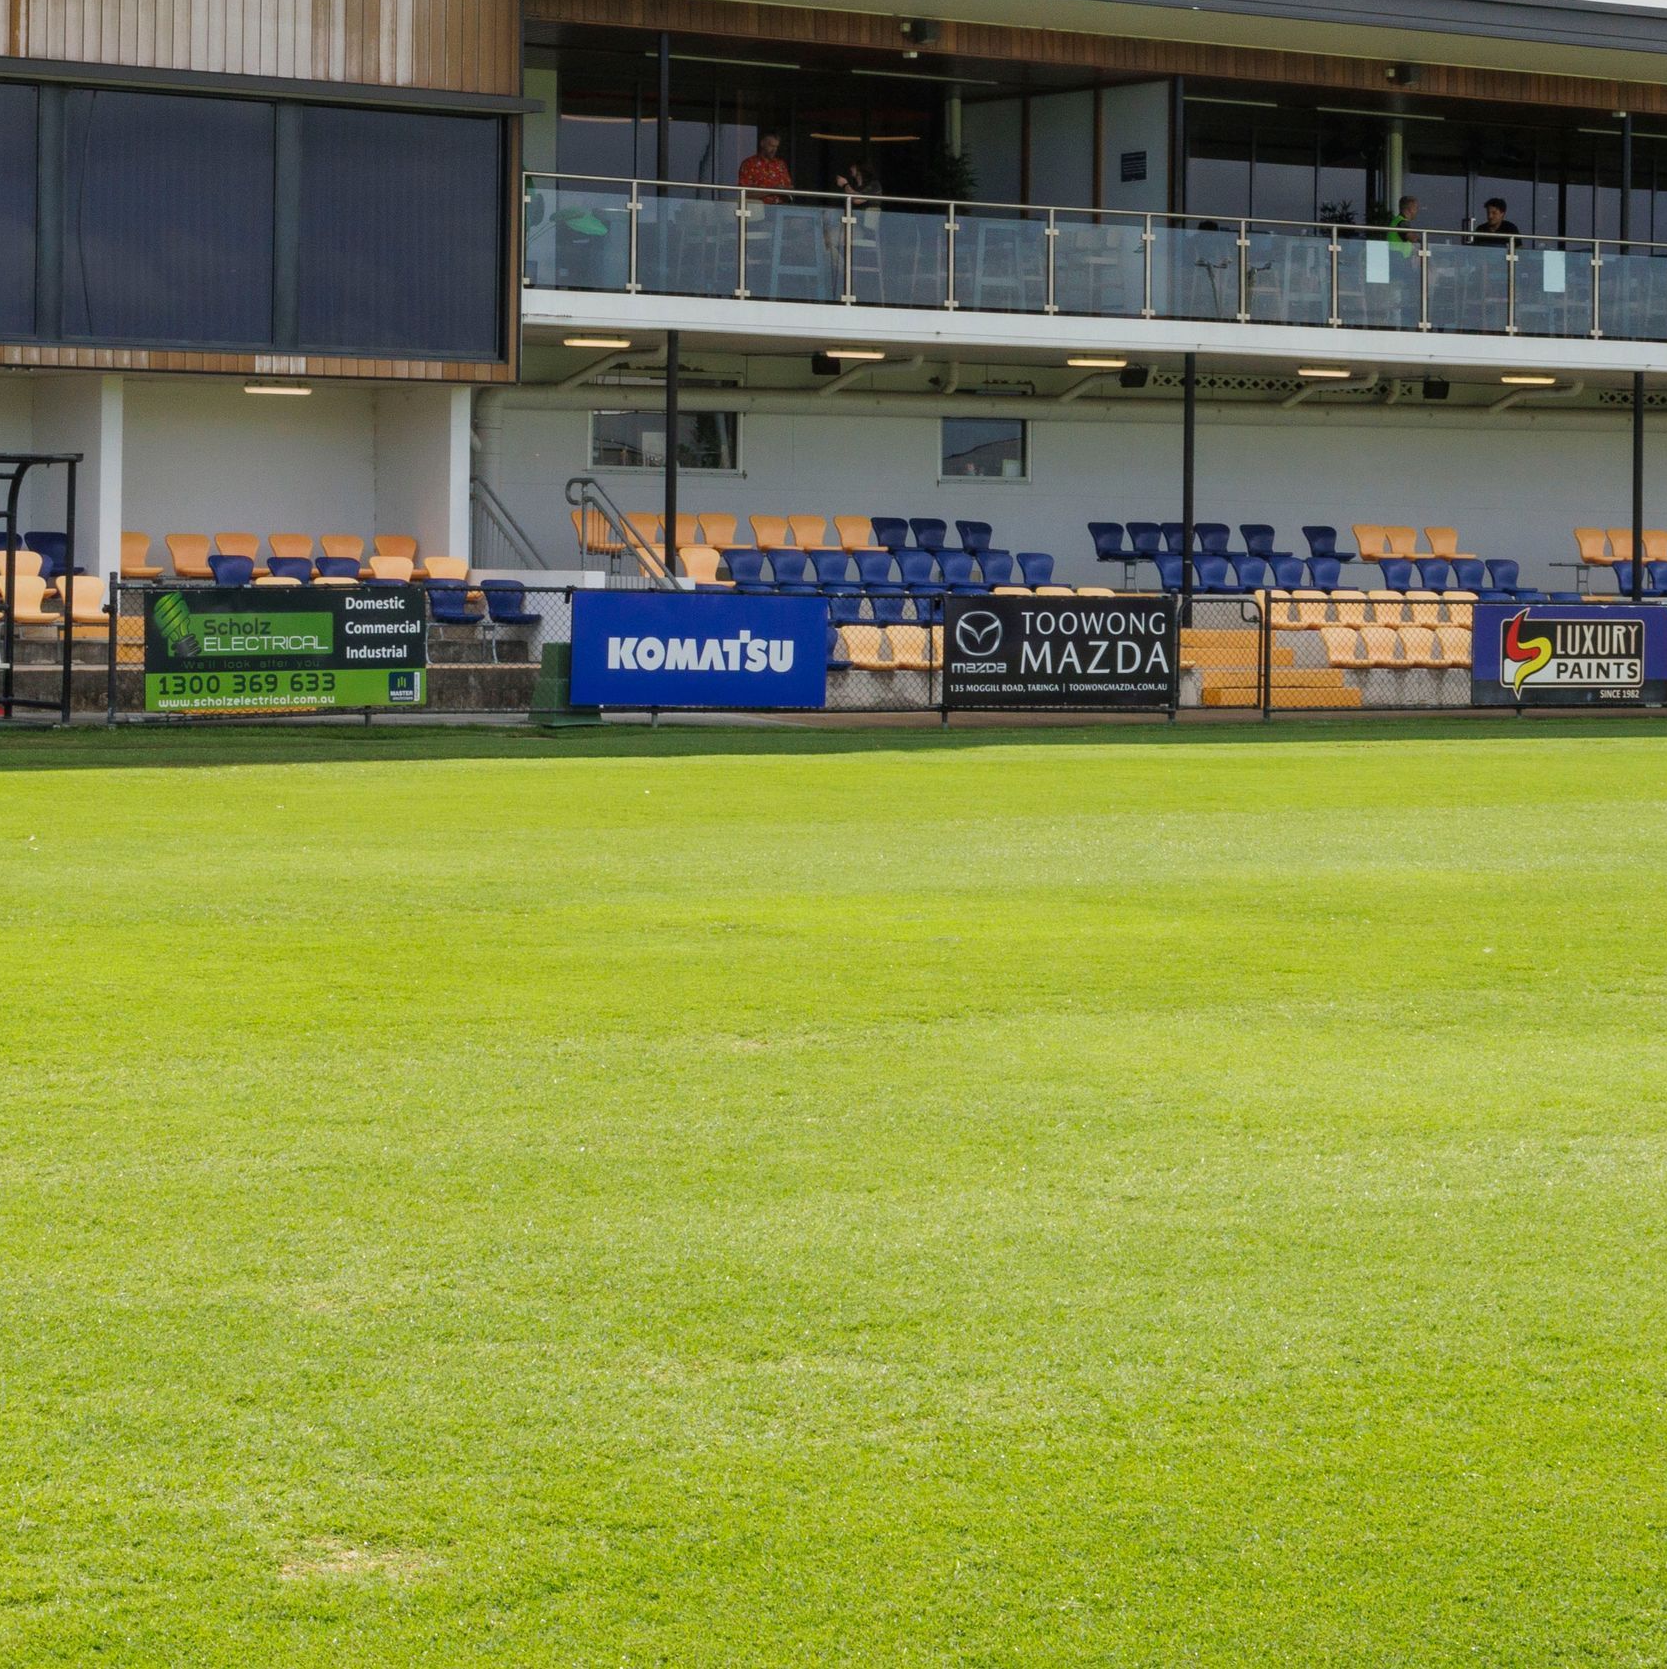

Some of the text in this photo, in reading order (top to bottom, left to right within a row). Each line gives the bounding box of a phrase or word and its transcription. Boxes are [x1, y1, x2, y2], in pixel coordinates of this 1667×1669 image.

[345, 596, 405, 610] Domestic
[204, 618, 271, 635] Scholz
[345, 620, 420, 634] Commercial
[1021, 612, 1166, 635] TOOWONG
[204, 635, 328, 652] ELECTRICAL
[1556, 624, 1639, 656] LUXURY
[346, 644, 407, 659] Industrial
[606, 629, 794, 673] KOMATSU
[1020, 641, 1170, 674] MAZDA
[951, 662, 1007, 674] mazda
[1556, 662, 1638, 679] PAINTS
[159, 673, 335, 695] 1300 369 633
[950, 683, 1168, 693] 135 MOGGILL ROAD, TARINGA TOOWONGMAZDA.COM.AU
[158, 695, 335, 708] www.scholzelectrical.com.au
[1600, 689, 1640, 699] SINCE 1982
